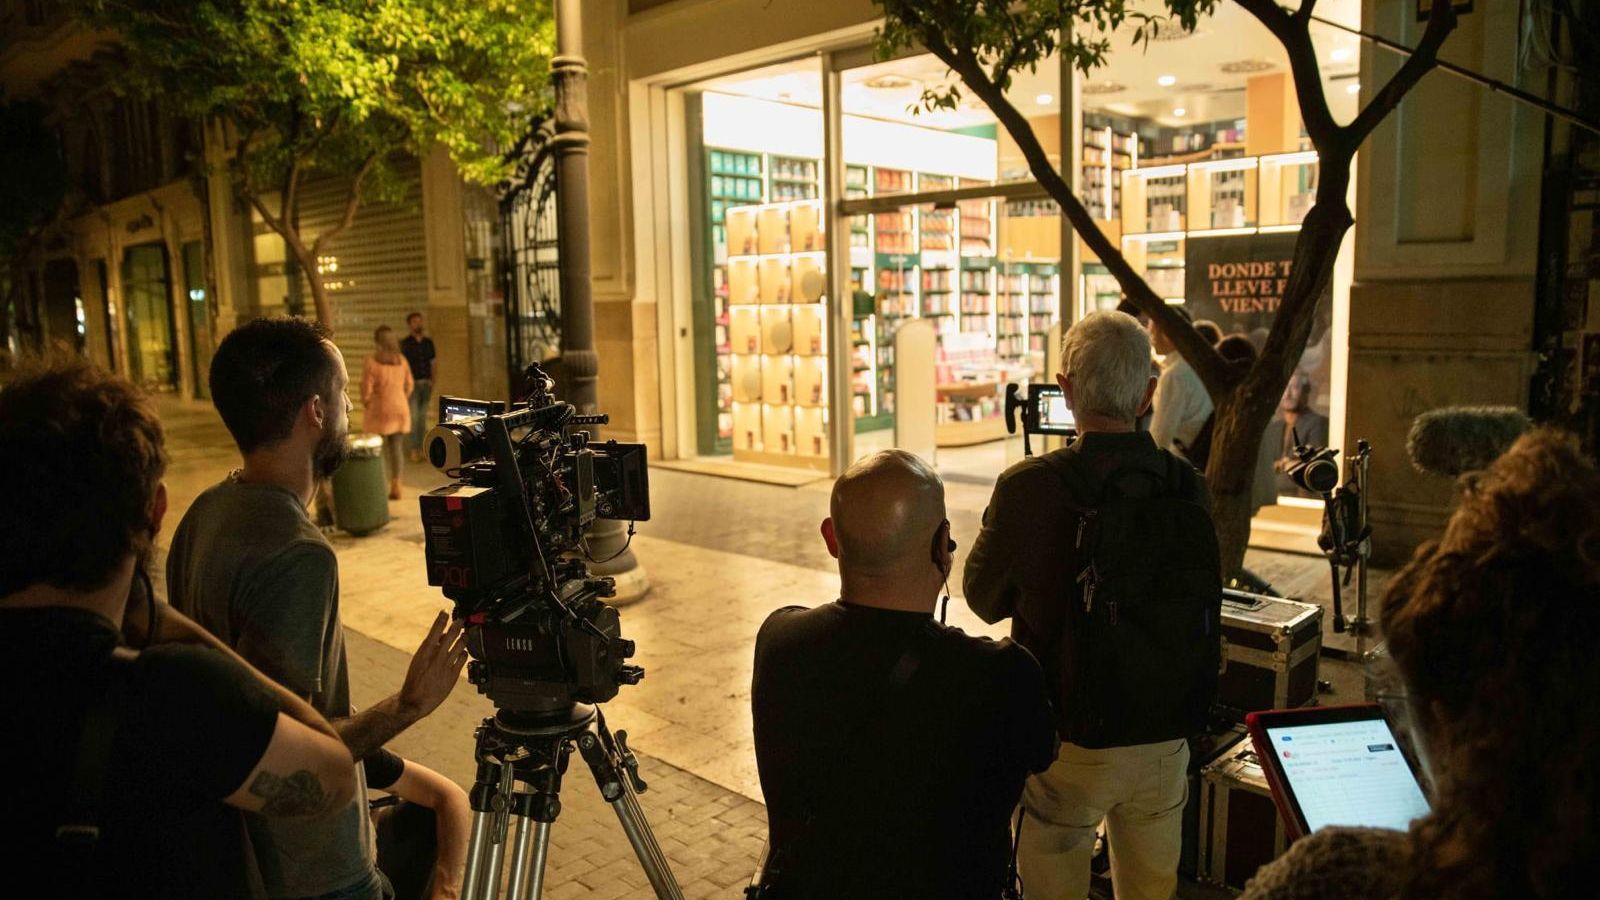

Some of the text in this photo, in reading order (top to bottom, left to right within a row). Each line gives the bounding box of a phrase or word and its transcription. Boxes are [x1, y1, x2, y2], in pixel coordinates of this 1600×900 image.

[1208, 260, 1293, 279] DONDE T
[1212, 280, 1272, 296] LLEVE
